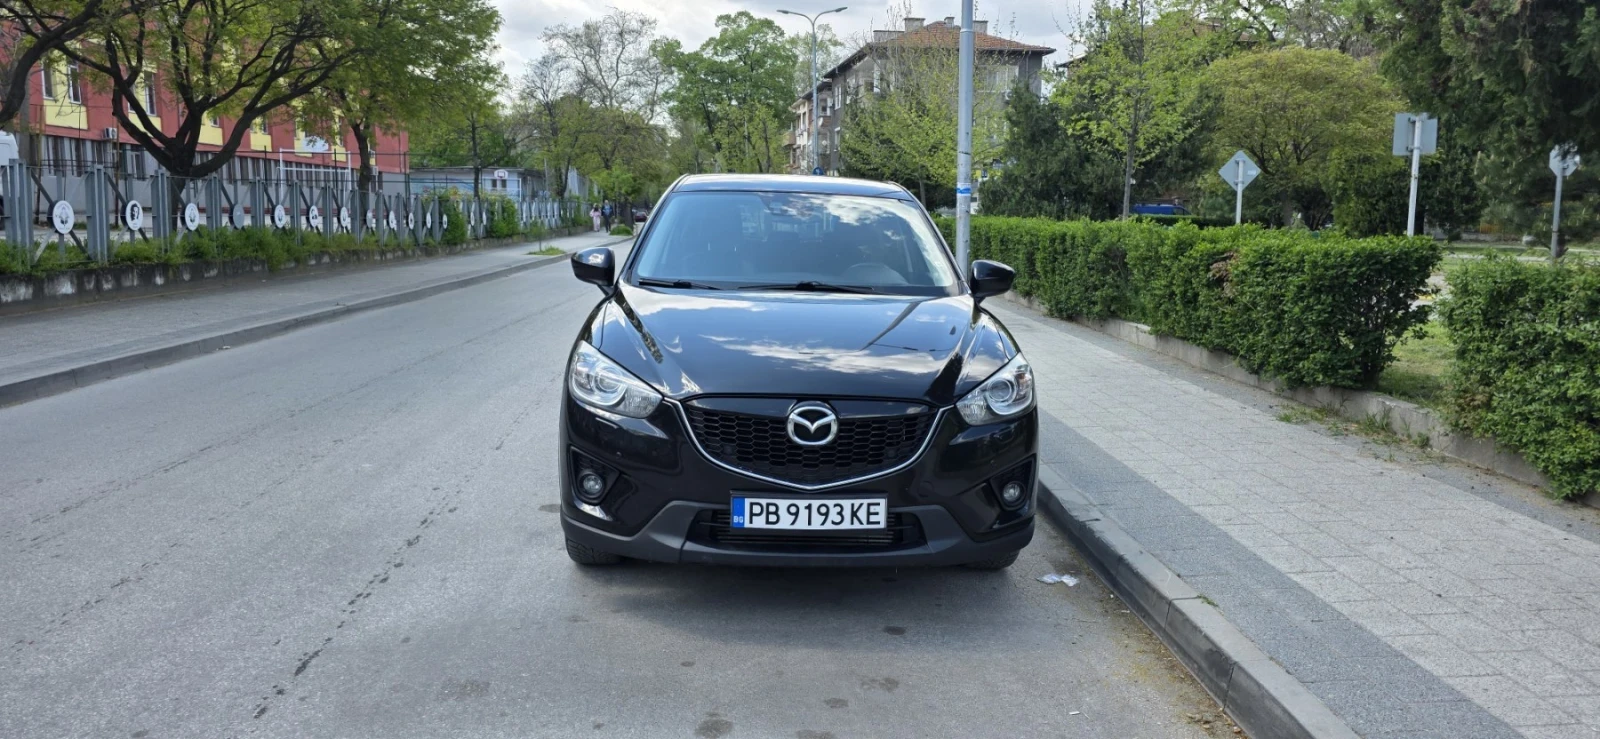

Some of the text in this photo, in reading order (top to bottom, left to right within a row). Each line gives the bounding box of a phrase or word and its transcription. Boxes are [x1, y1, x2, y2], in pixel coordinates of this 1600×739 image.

[749, 502, 881, 526] PB 9193 KE
